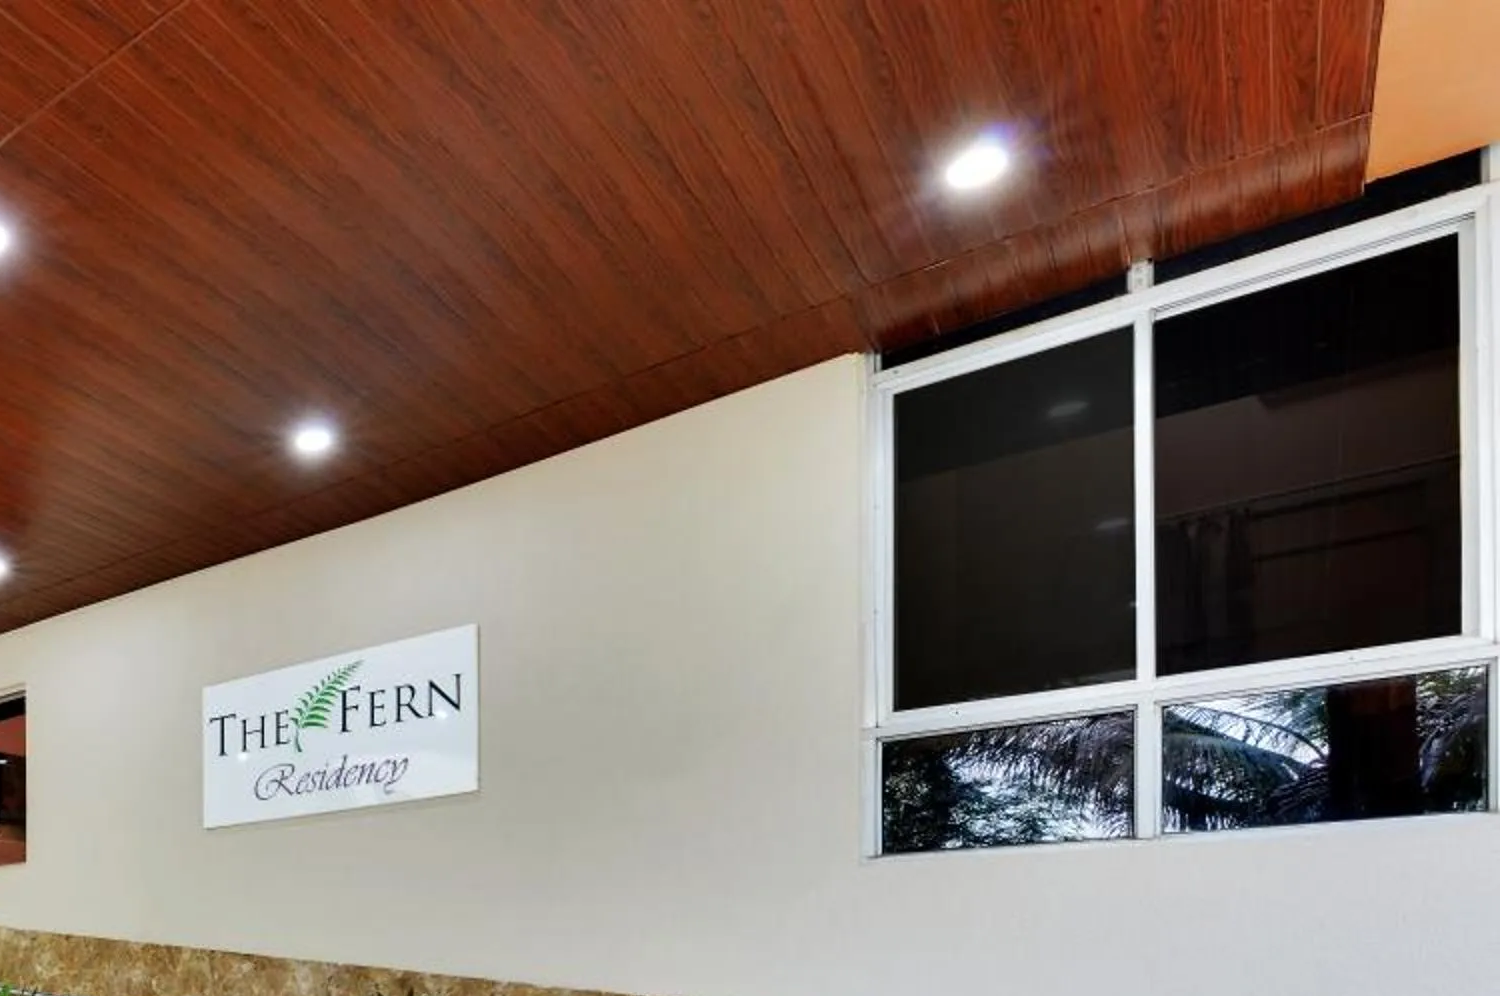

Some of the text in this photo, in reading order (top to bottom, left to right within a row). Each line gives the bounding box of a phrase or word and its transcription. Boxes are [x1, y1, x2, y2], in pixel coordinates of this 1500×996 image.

[209, 673, 462, 756] THE FERN
[254, 754, 409, 801] Residency
